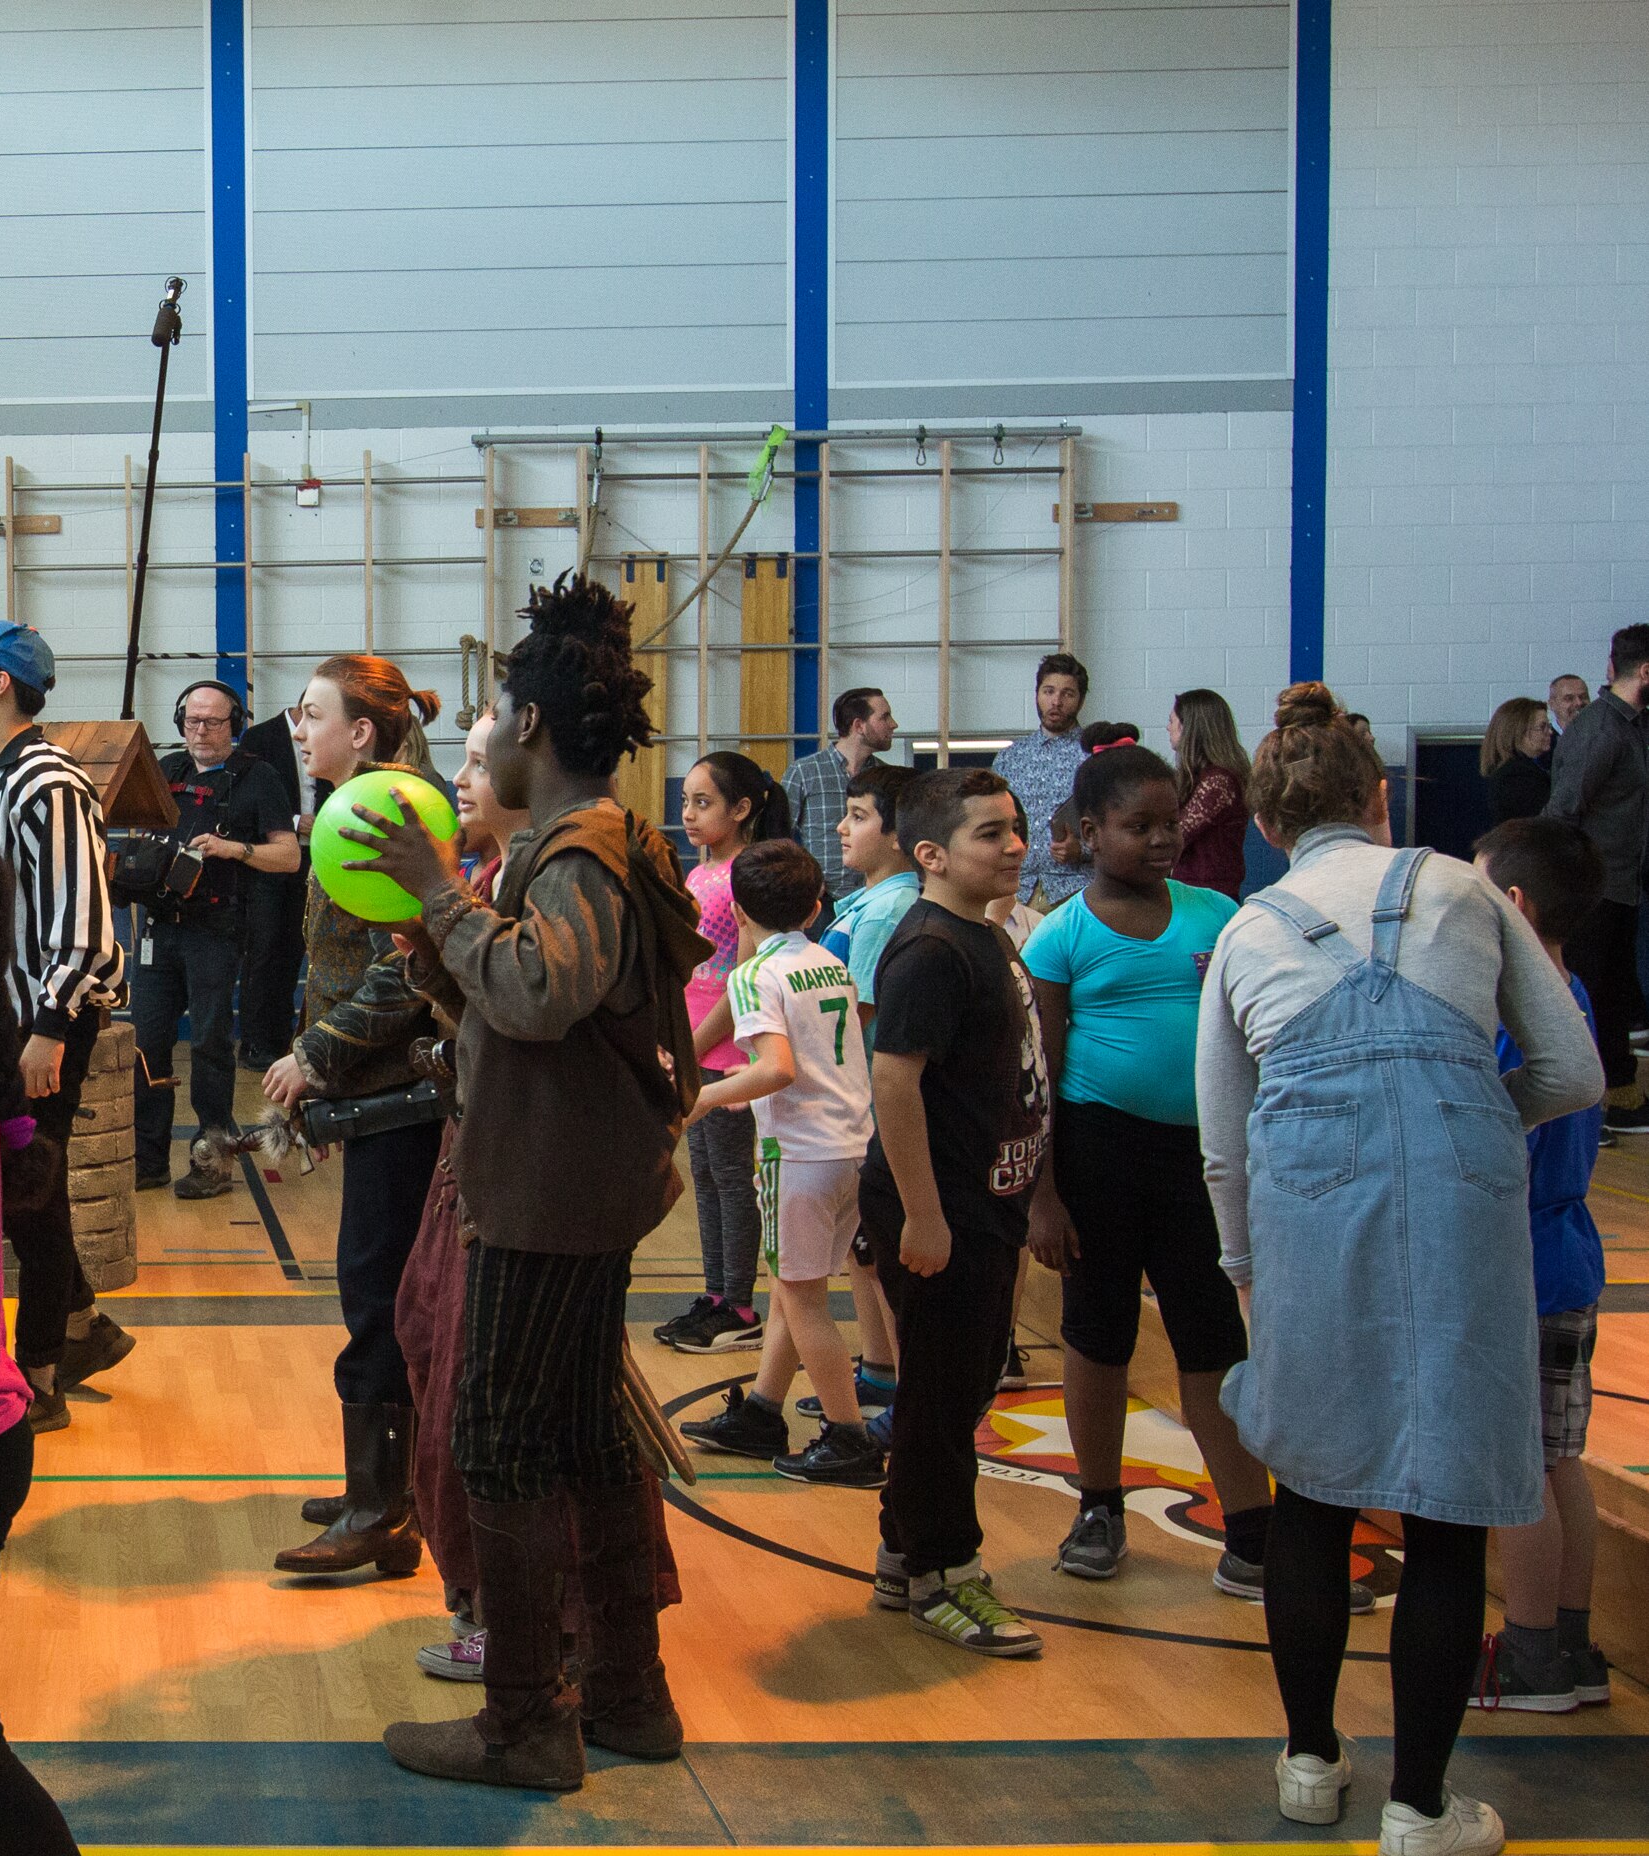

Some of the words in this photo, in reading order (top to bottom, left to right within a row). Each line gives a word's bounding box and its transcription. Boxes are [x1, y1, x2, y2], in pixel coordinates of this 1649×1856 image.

[785, 965, 853, 993] MAHREZ
[819, 996, 849, 1066] 7
[978, 1463, 1042, 1482] ECOL
